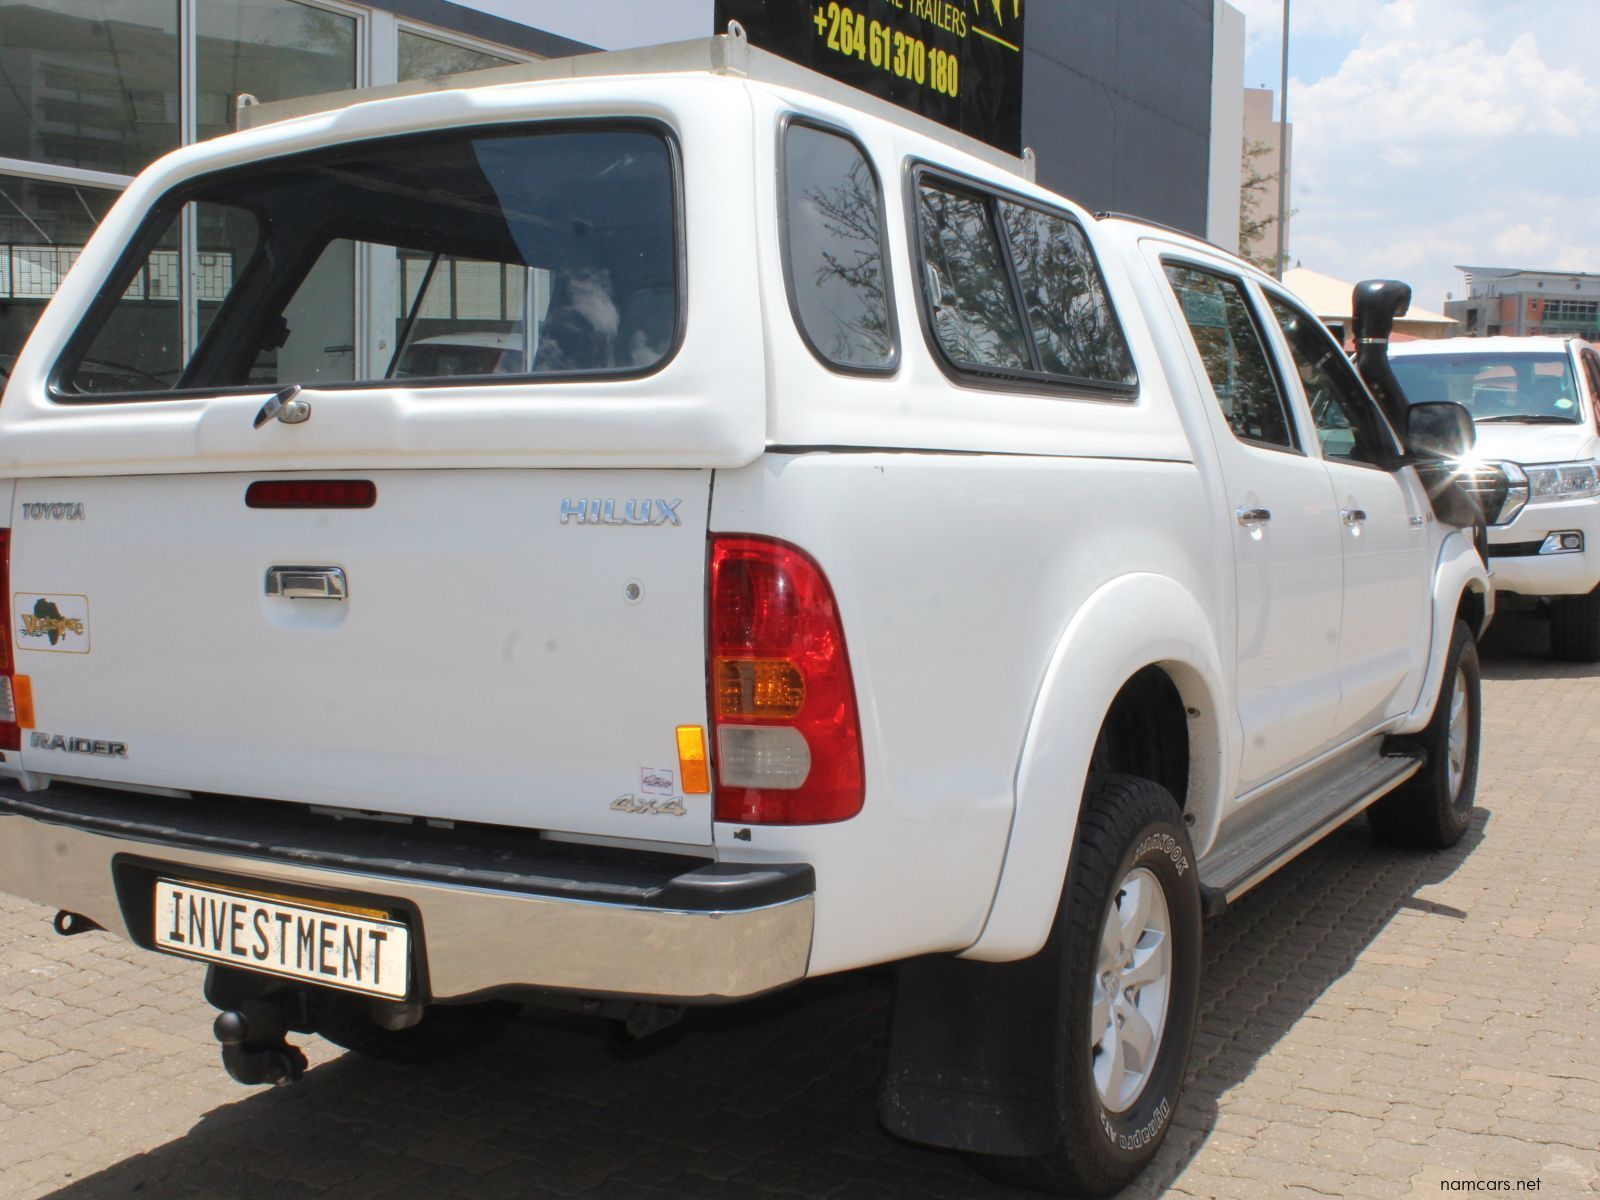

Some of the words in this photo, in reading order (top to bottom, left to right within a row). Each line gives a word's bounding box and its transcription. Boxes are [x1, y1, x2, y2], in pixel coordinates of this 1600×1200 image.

[814, 2, 866, 61] +264
[869, 20, 891, 71] 61
[893, 31, 925, 85] 370
[928, 47, 958, 98] 180
[22, 502, 86, 521] TOYOTA
[560, 498, 682, 526] HILUX
[31, 731, 129, 759] RAIDER
[169, 891, 388, 985] INVESTMENT
[1119, 1097, 1170, 1150] Dynapro
